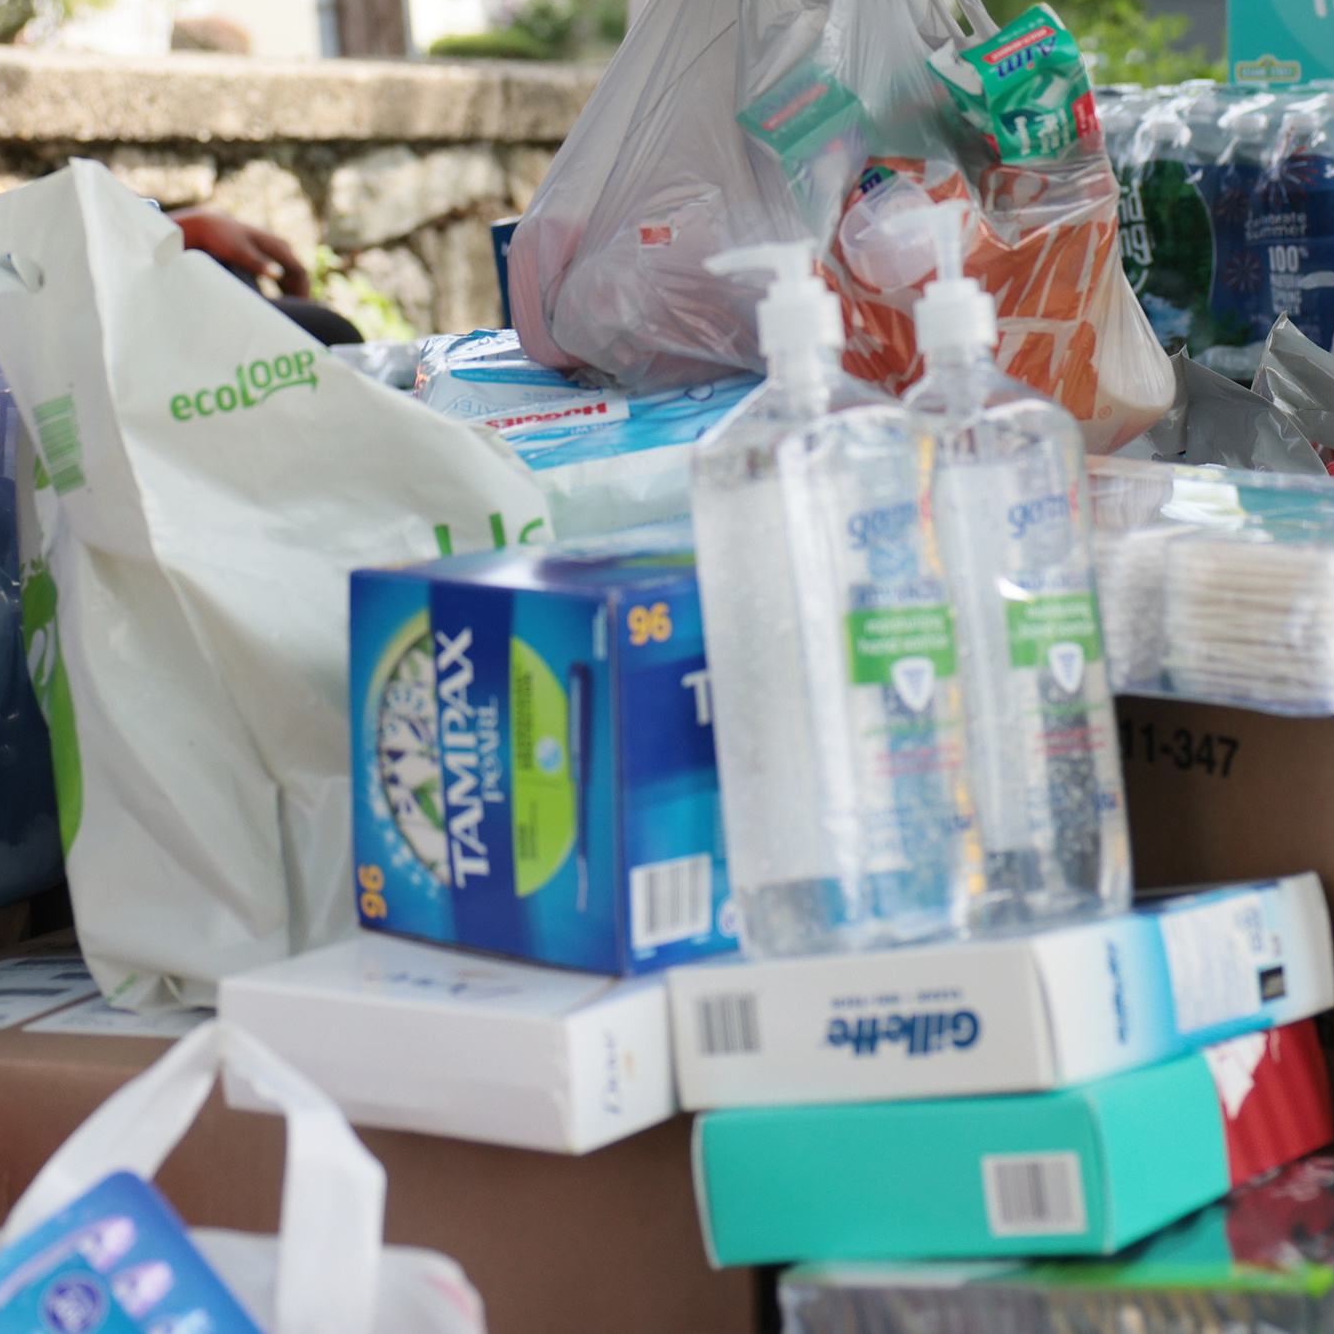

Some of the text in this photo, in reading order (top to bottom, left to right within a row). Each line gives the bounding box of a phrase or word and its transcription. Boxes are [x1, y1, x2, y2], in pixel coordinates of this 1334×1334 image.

[997, 35, 1058, 79] Aim
[1268, 245, 1309, 272] 100%
[626, 601, 673, 646] 96
[435, 627, 491, 889] TAMPAX
[358, 863, 387, 919] 96
[827, 1010, 981, 1058] Gillette
